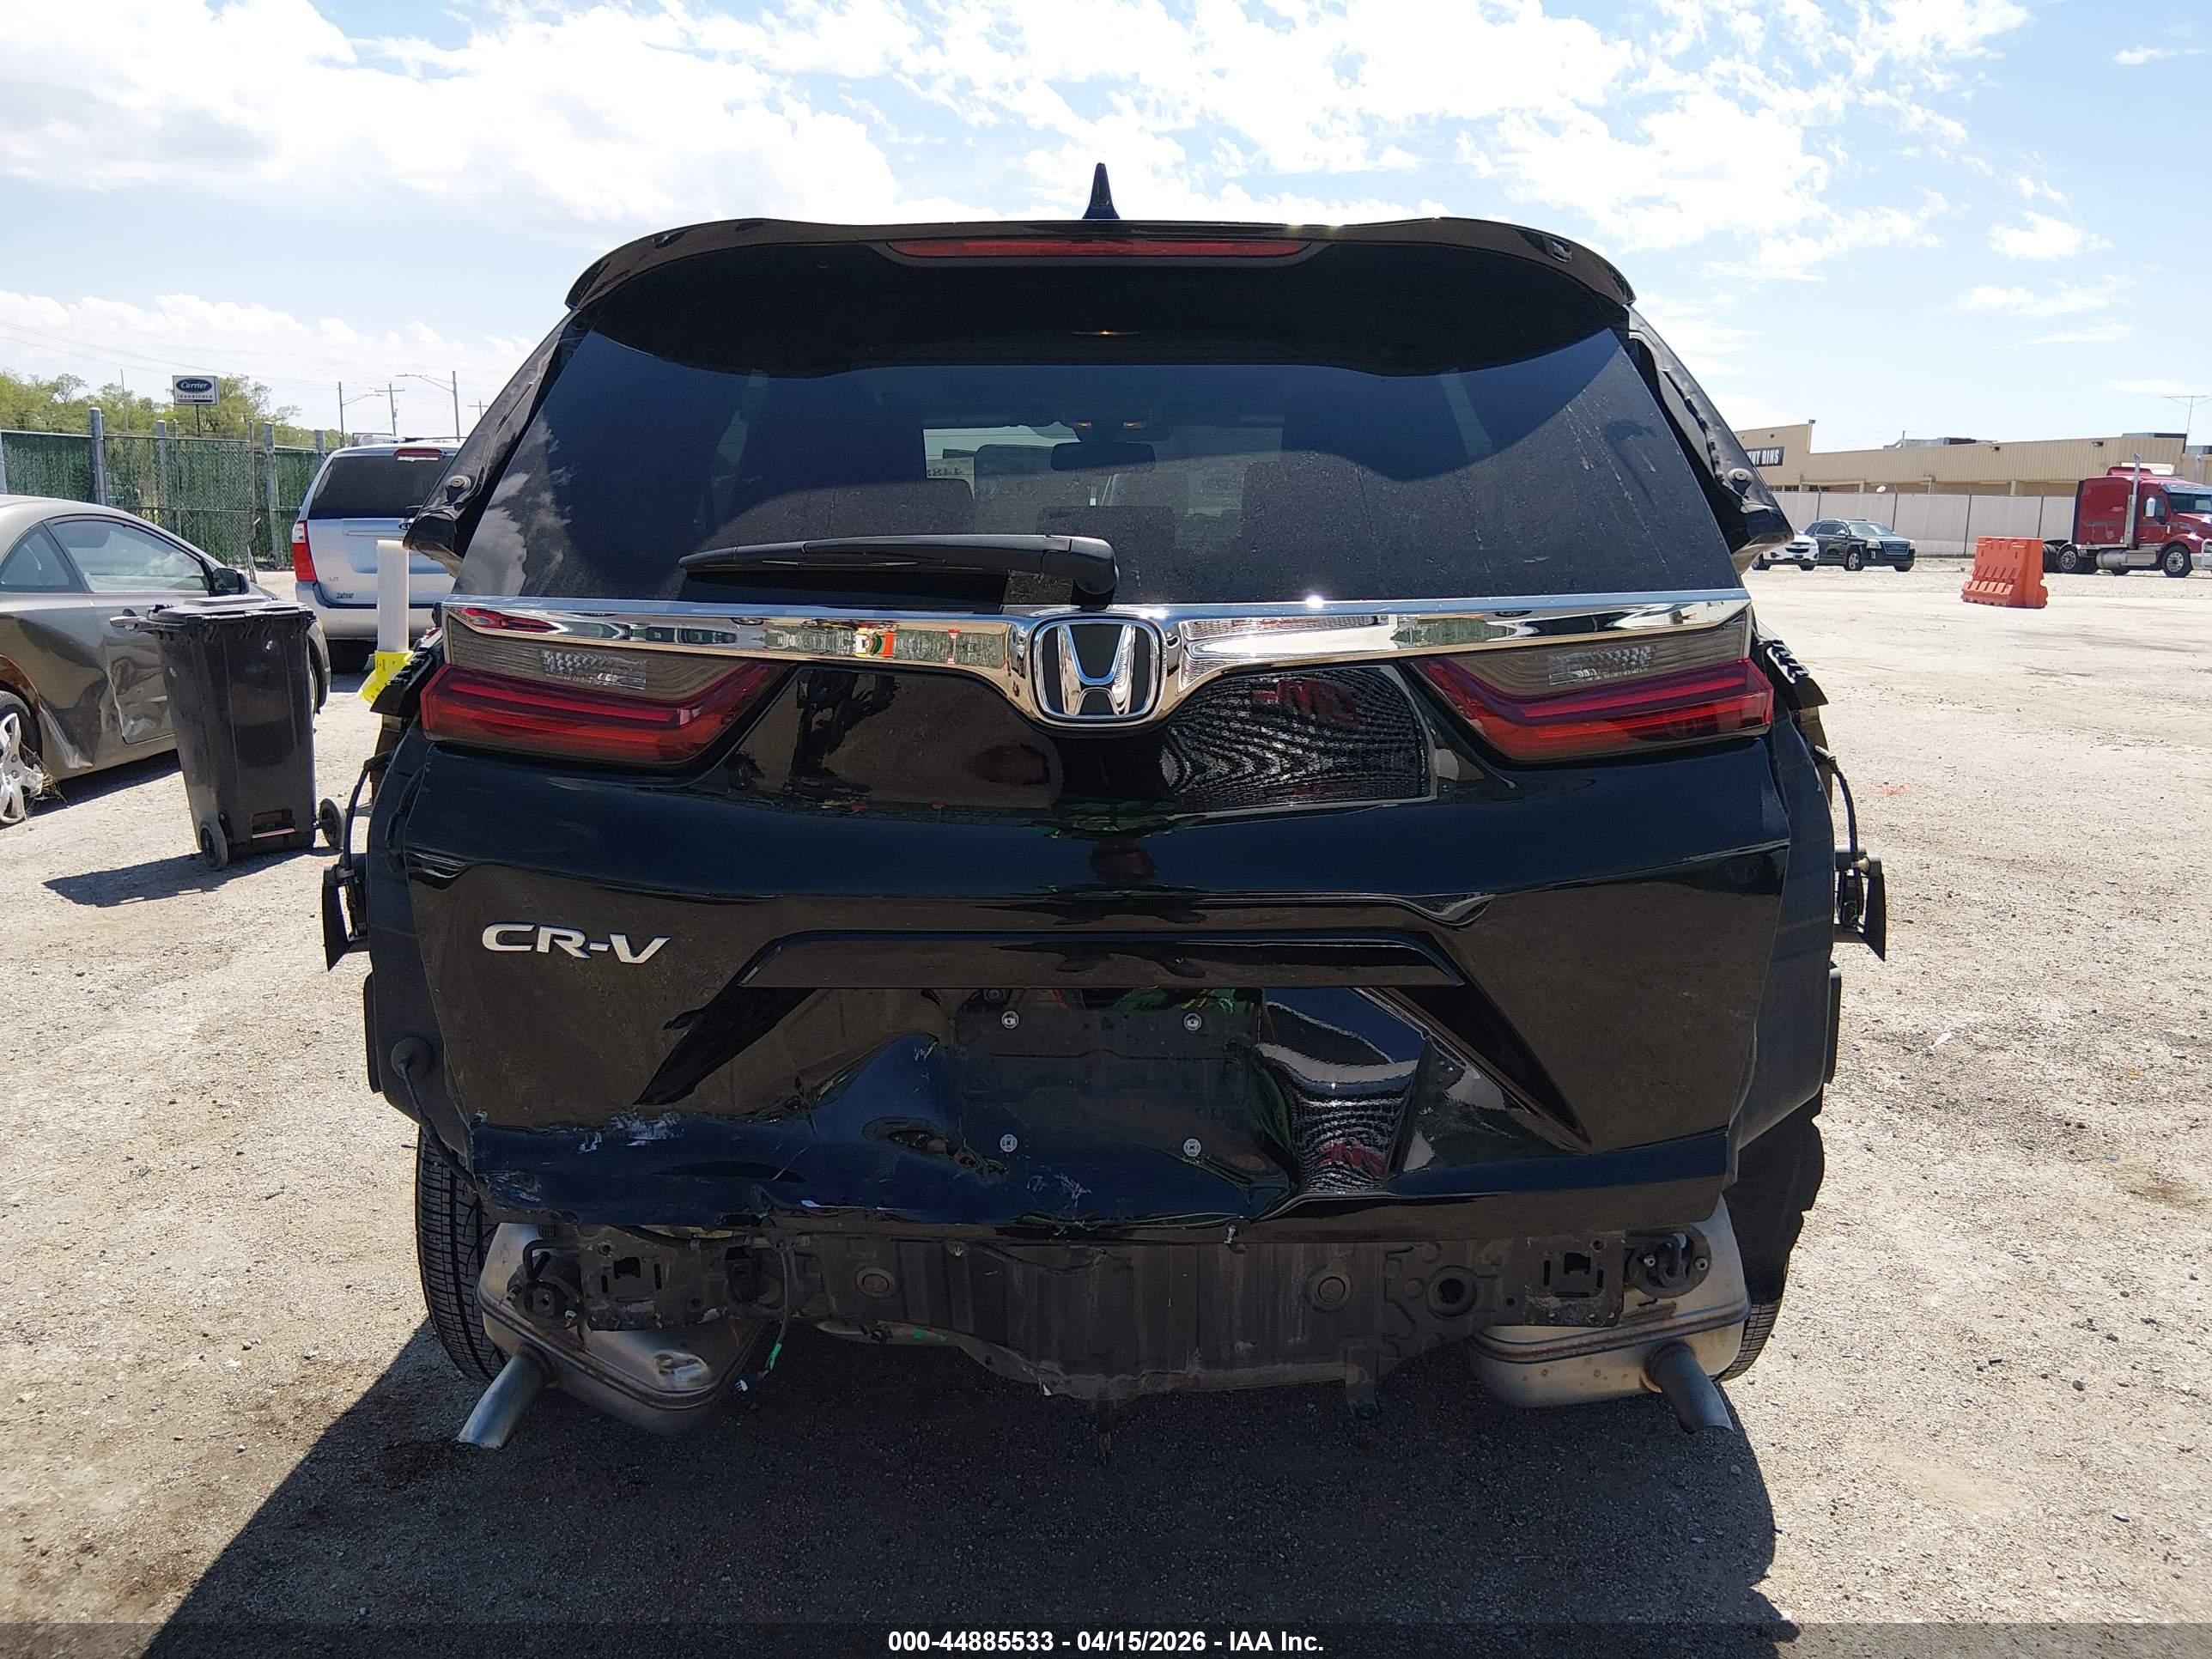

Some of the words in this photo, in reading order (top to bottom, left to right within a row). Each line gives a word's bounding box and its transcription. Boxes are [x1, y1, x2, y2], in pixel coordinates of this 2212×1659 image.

[181, 381, 208, 390] Carrier
[1761, 449, 1779, 465] BINS
[482, 922, 671, 963] CR-V
